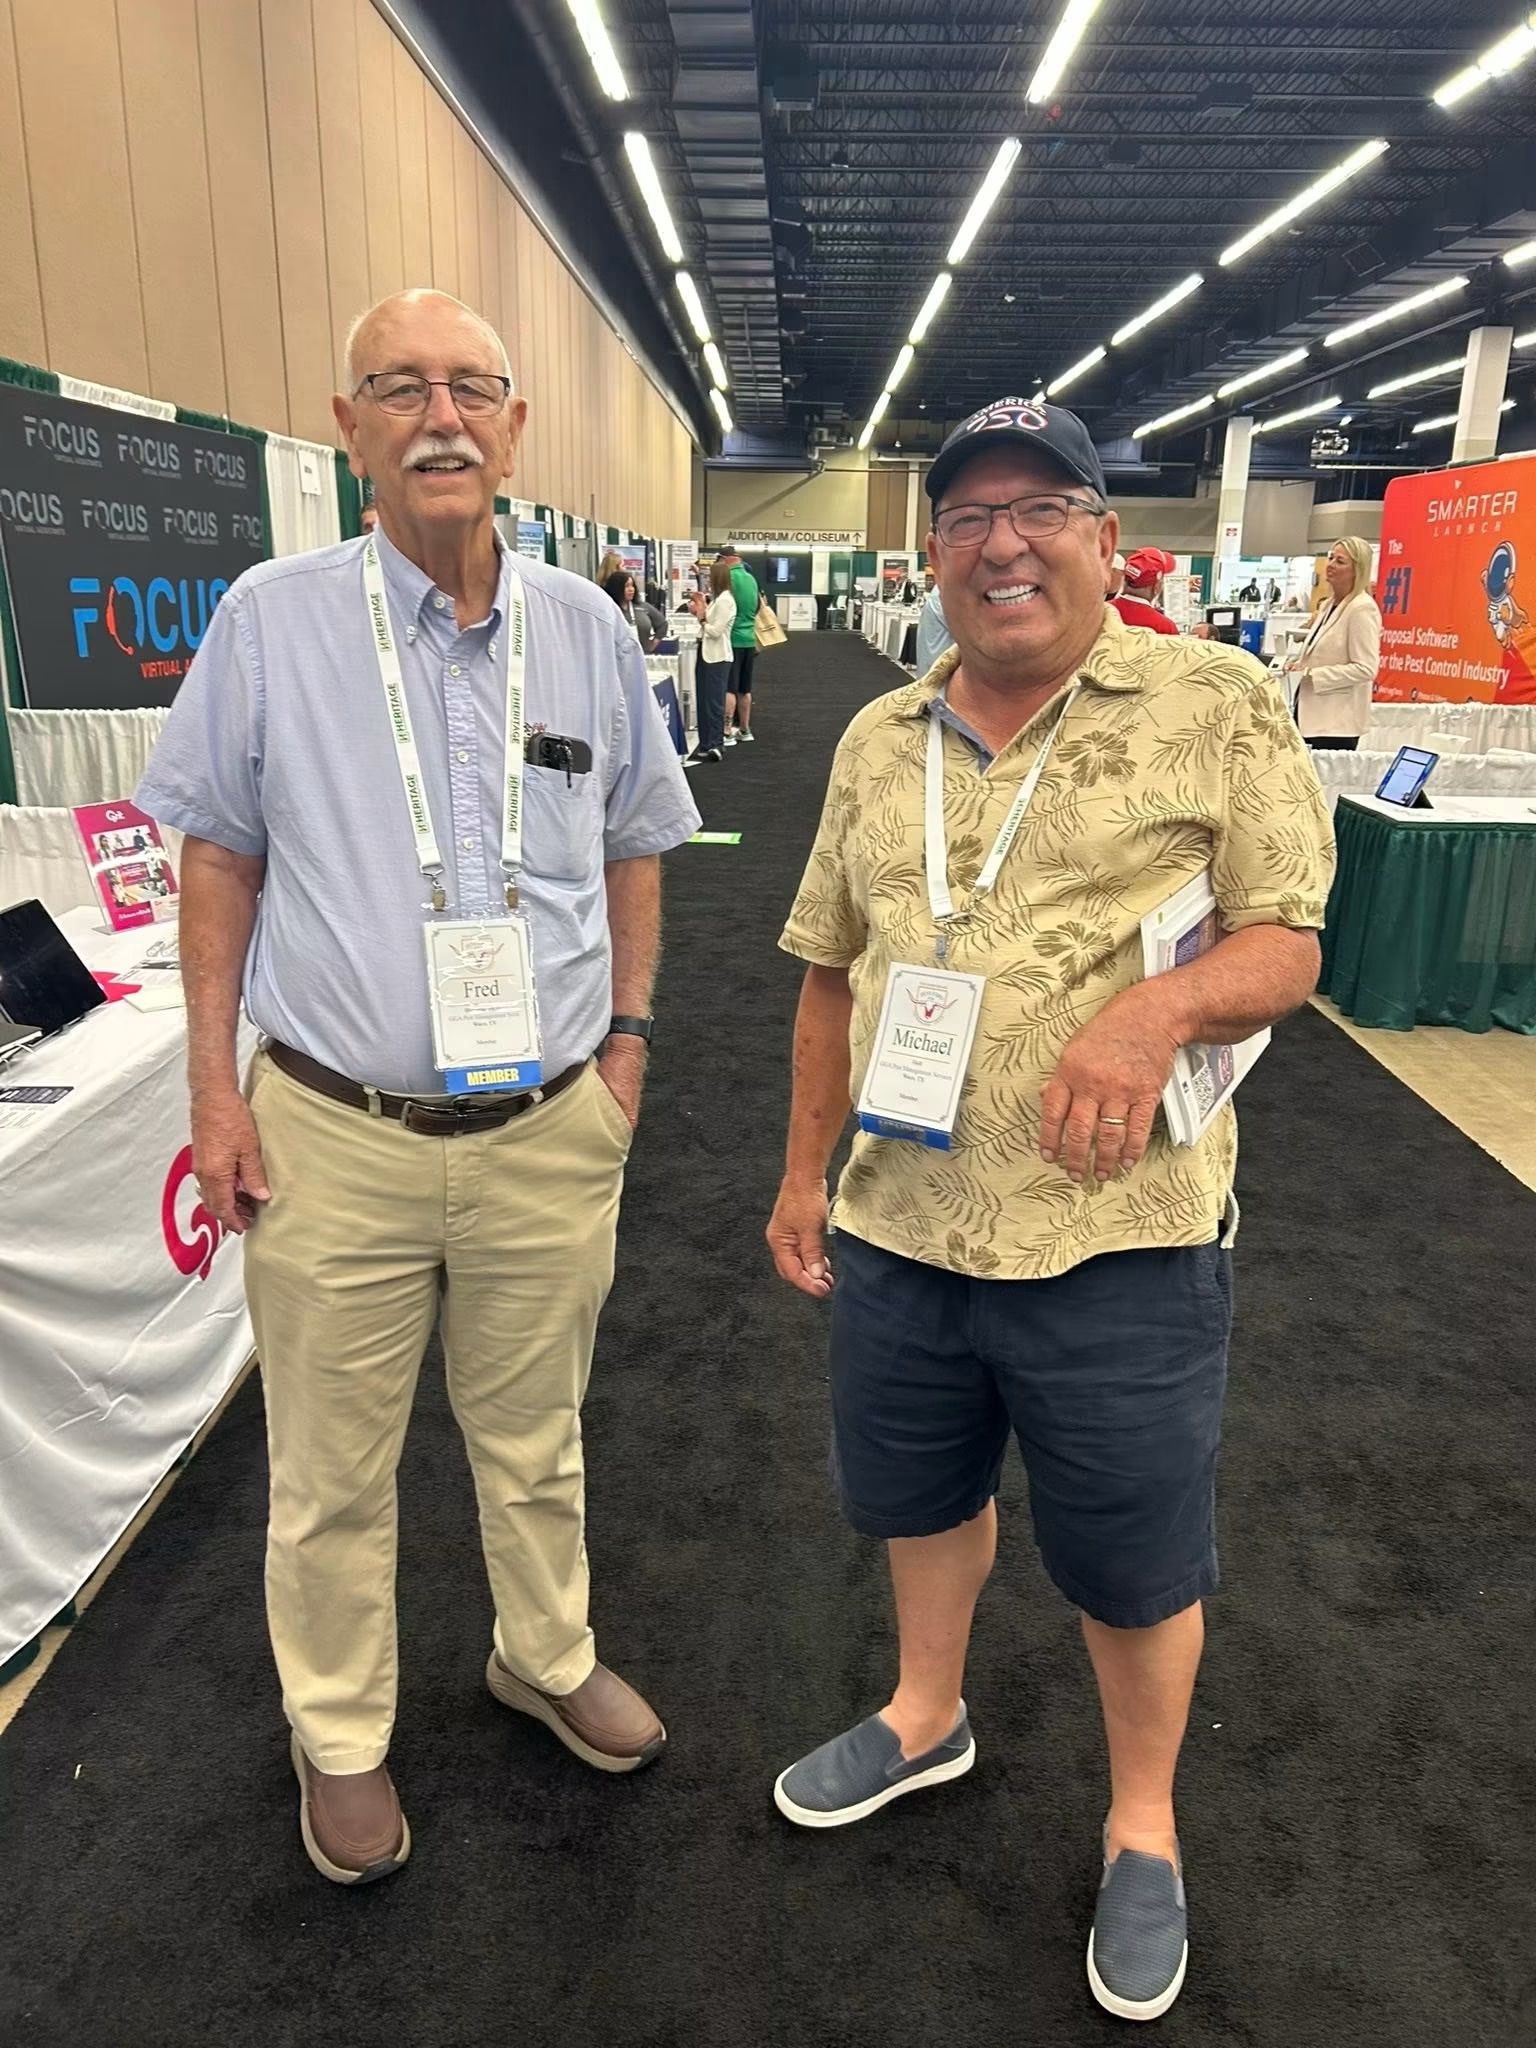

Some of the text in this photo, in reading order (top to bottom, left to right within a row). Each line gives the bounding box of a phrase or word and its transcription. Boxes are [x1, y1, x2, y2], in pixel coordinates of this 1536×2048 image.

[23, 415, 100, 458] FOCUS
[117, 433, 180, 471] FOCUS
[194, 448, 246, 481] FOCUS
[0, 488, 63, 525] OCUS
[81, 499, 148, 533] FOCUS
[163, 507, 218, 537] FOCUS
[1427, 489, 1518, 523] SMARTER
[232, 513, 262, 540] FOC
[1433, 520, 1502, 537] LAUNCH
[1387, 538, 1403, 555] The
[1382, 566, 1412, 615] #1
[369, 592, 389, 641] HERITAGE
[512, 611, 522, 657] HERITAGE
[1416, 627, 1459, 650] Software
[139, 659, 183, 678] VIRTUAL
[1389, 652, 1403, 669] the
[1404, 654, 1424, 672] Pest
[1425, 656, 1461, 680] Control
[1462, 660, 1511, 690] Industry
[386, 683, 408, 733] HERITAGE
[510, 698, 521, 744] HERITAGE
[406, 774, 426, 825] HERITAGE
[508, 784, 519, 833] HERITAGE
[995, 808, 1022, 855] HERITAGE
[463, 979, 500, 999] Fred
[892, 1027, 954, 1057] Michael
[466, 1068, 519, 1086] MEMBER
